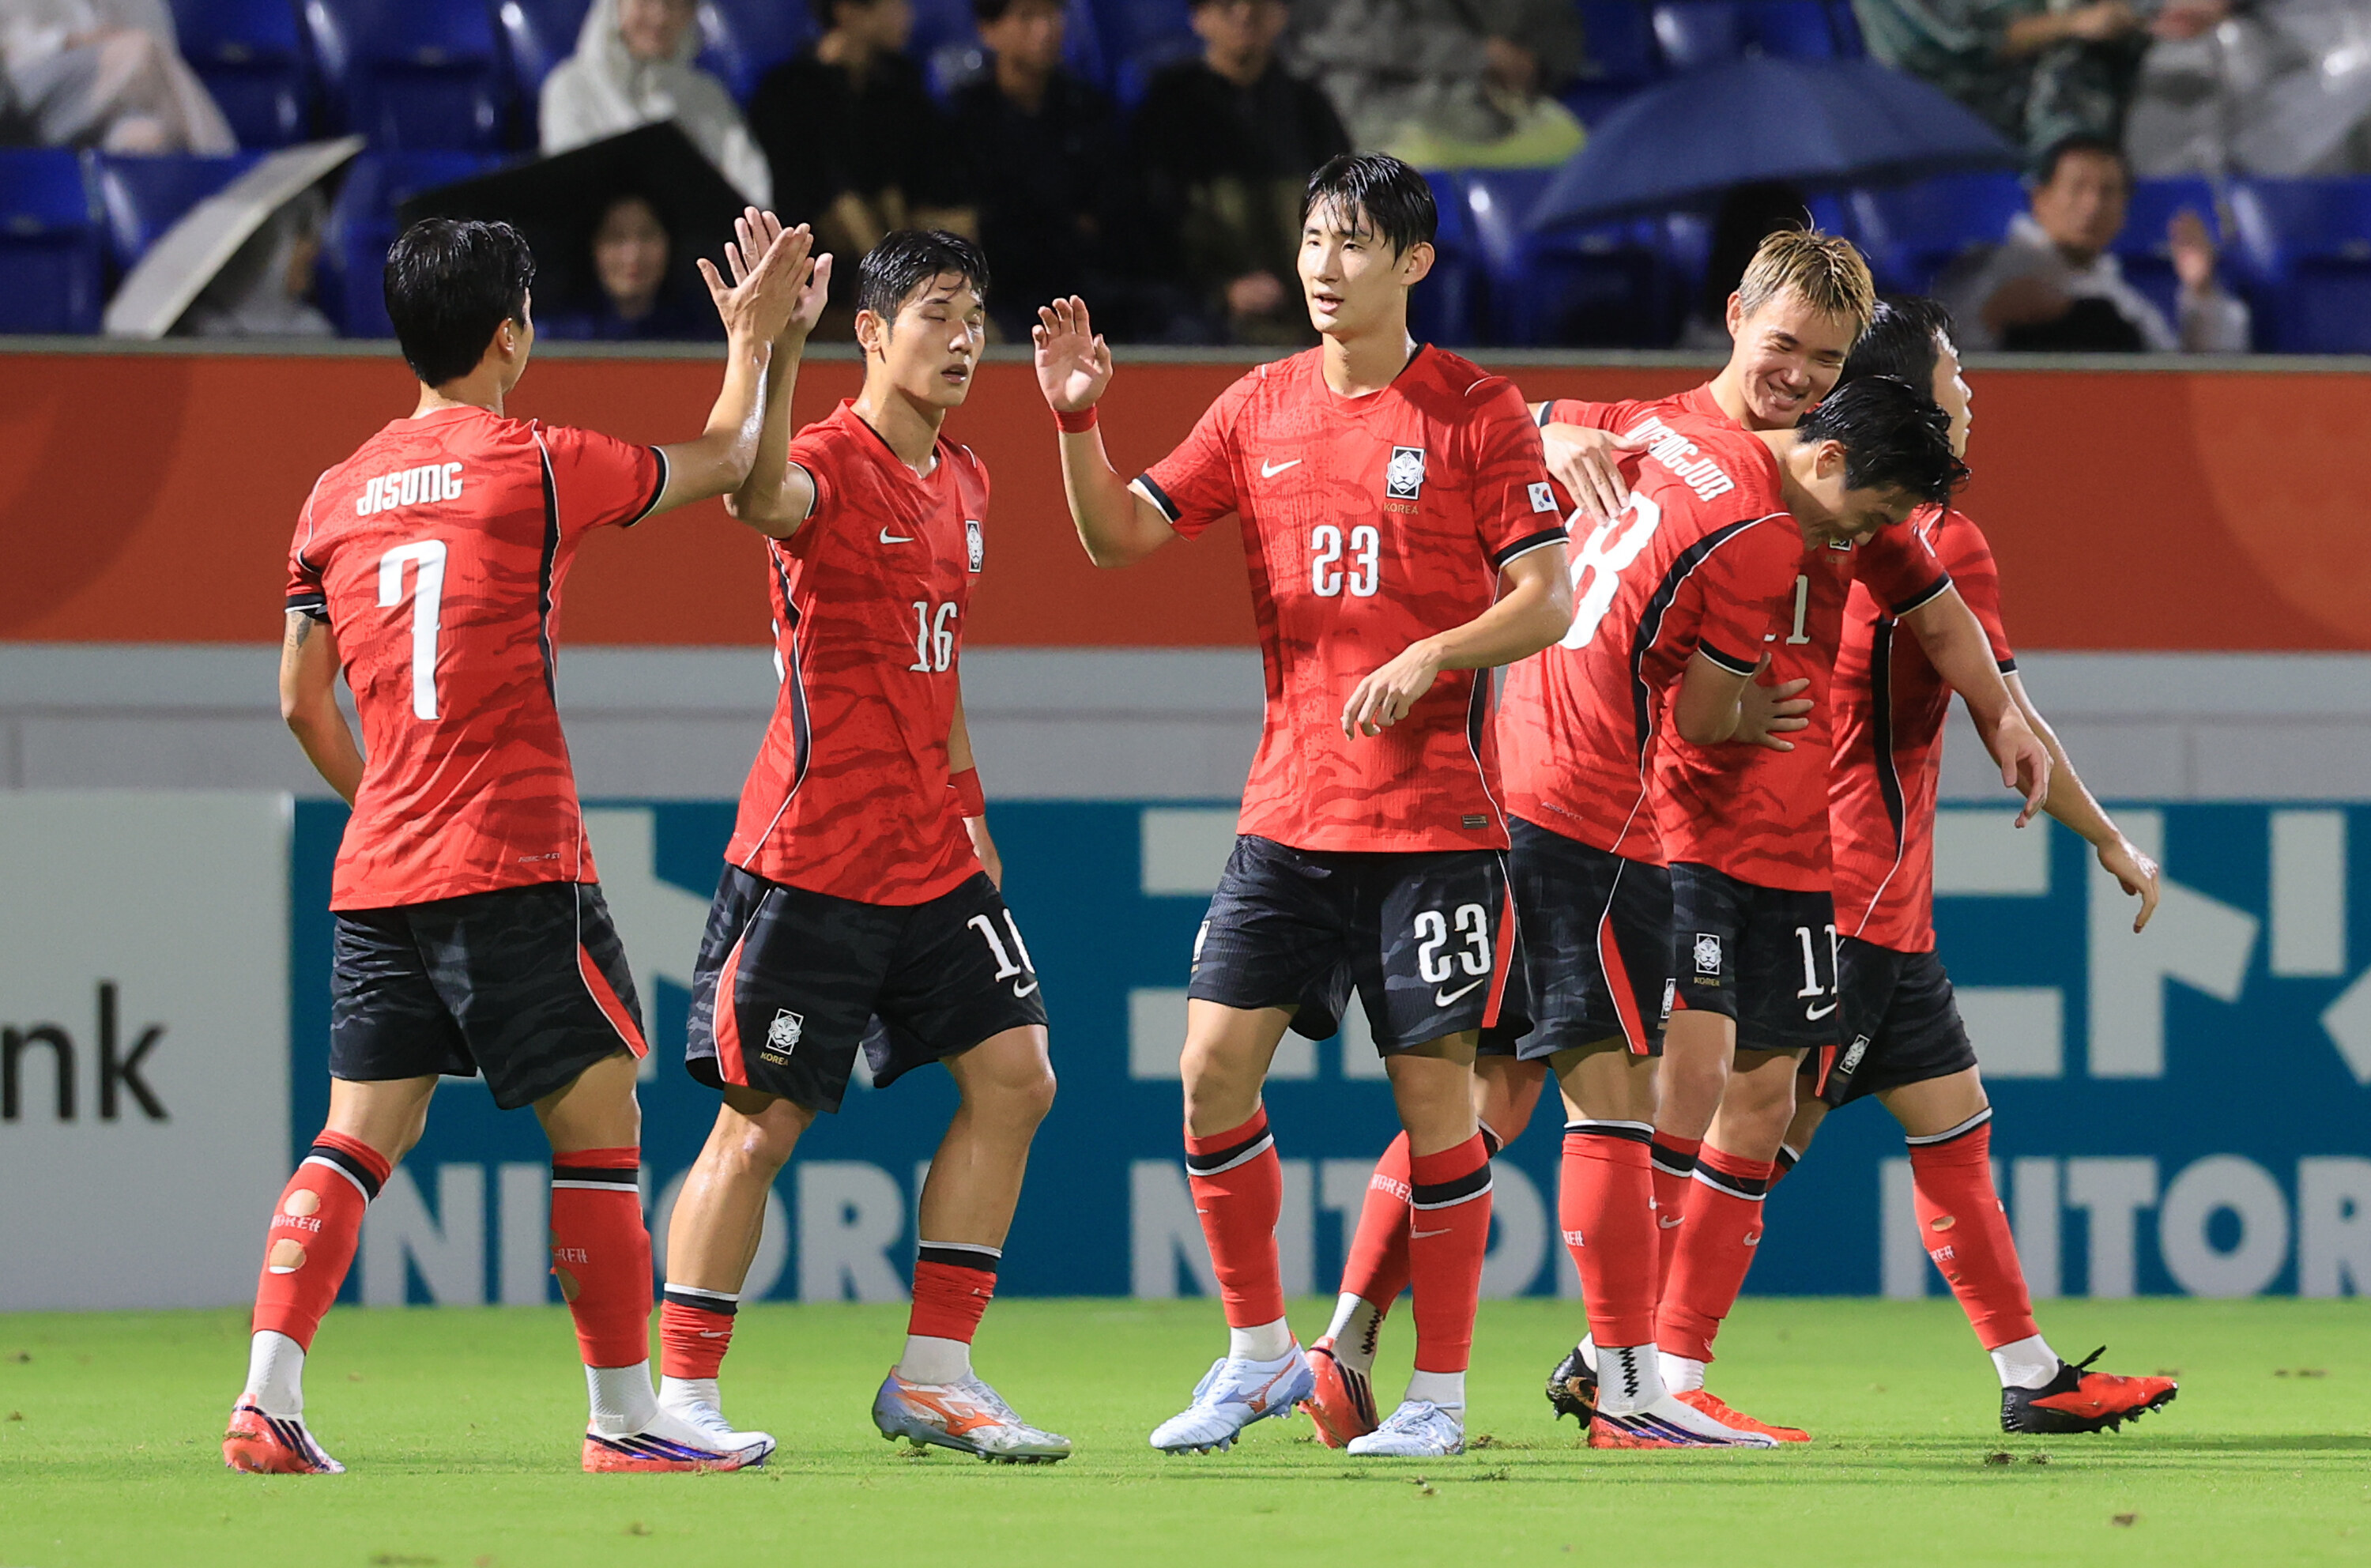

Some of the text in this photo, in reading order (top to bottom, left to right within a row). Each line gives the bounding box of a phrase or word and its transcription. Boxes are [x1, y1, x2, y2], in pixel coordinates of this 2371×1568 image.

[356, 462, 463, 516] JISUNG
[1384, 502, 1419, 514] KOREA
[1311, 525, 1380, 597] 23
[1559, 491, 1661, 650] 8
[376, 539, 447, 720] 7
[910, 601, 959, 673] 16
[1764, 574, 1811, 646] 1
[1413, 903, 1491, 984] 23
[2, 980, 168, 1121] nk
[760, 1051, 789, 1066] KOREA
